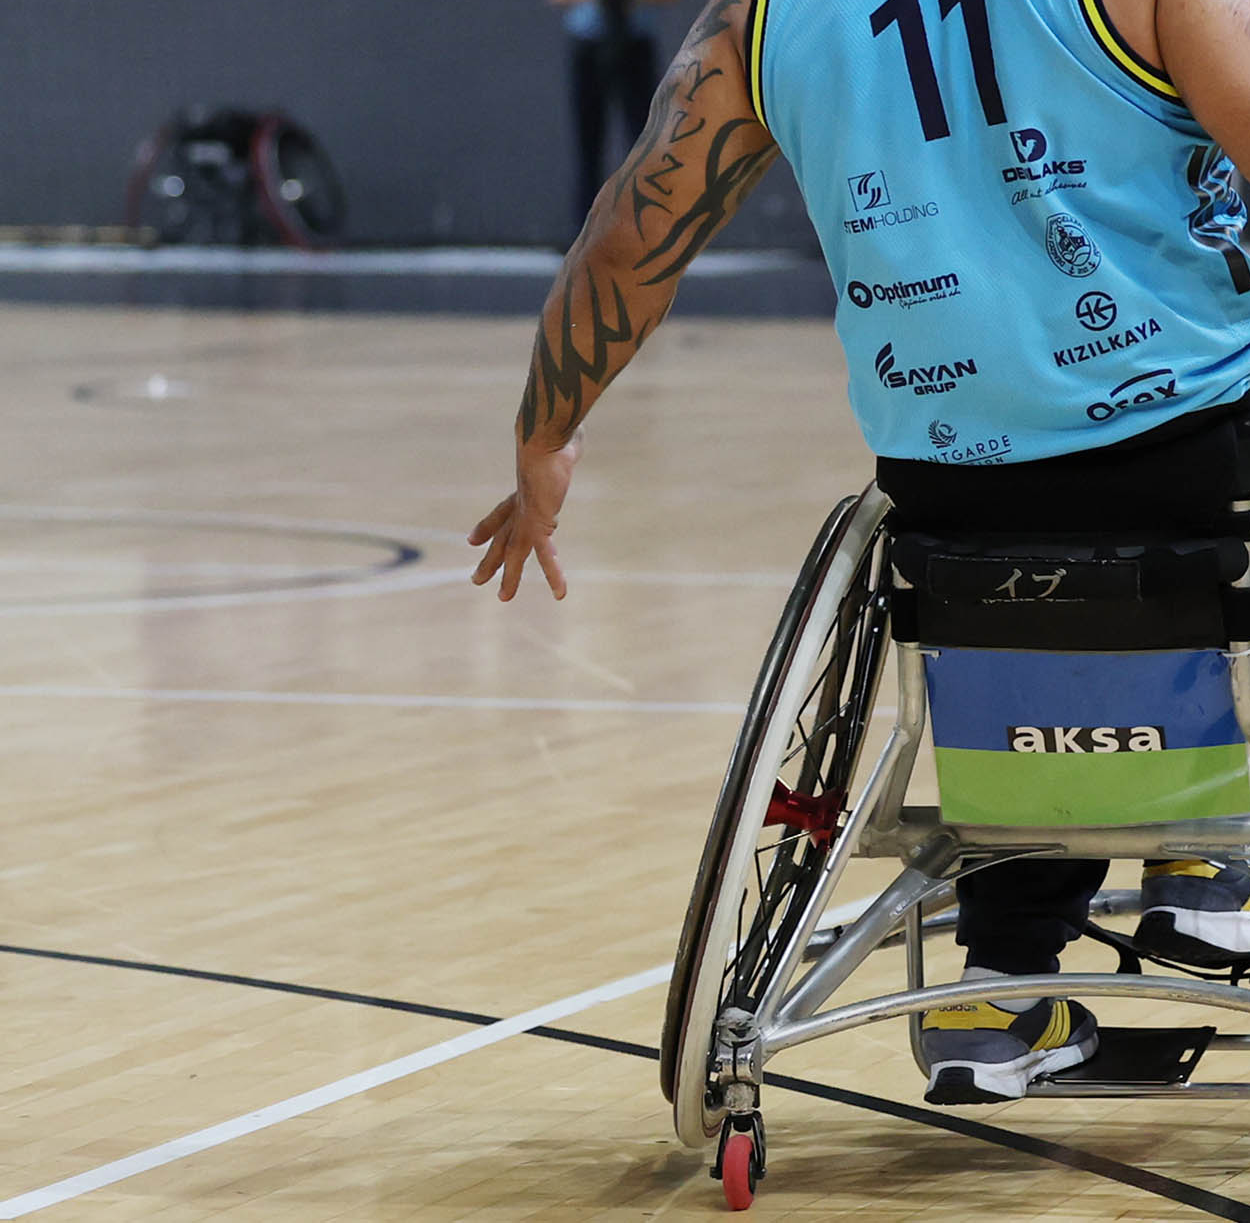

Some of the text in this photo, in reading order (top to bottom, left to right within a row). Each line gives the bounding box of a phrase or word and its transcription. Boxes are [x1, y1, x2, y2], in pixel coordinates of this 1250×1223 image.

[1002, 160, 1085, 183] DELAKS
[873, 273, 959, 305] Optimum
[1053, 318, 1163, 368] KIZILKAYA
[887, 358, 978, 389] SAYAN
[914, 381, 957, 396] GRUP
[1012, 725, 1163, 754] aksa
